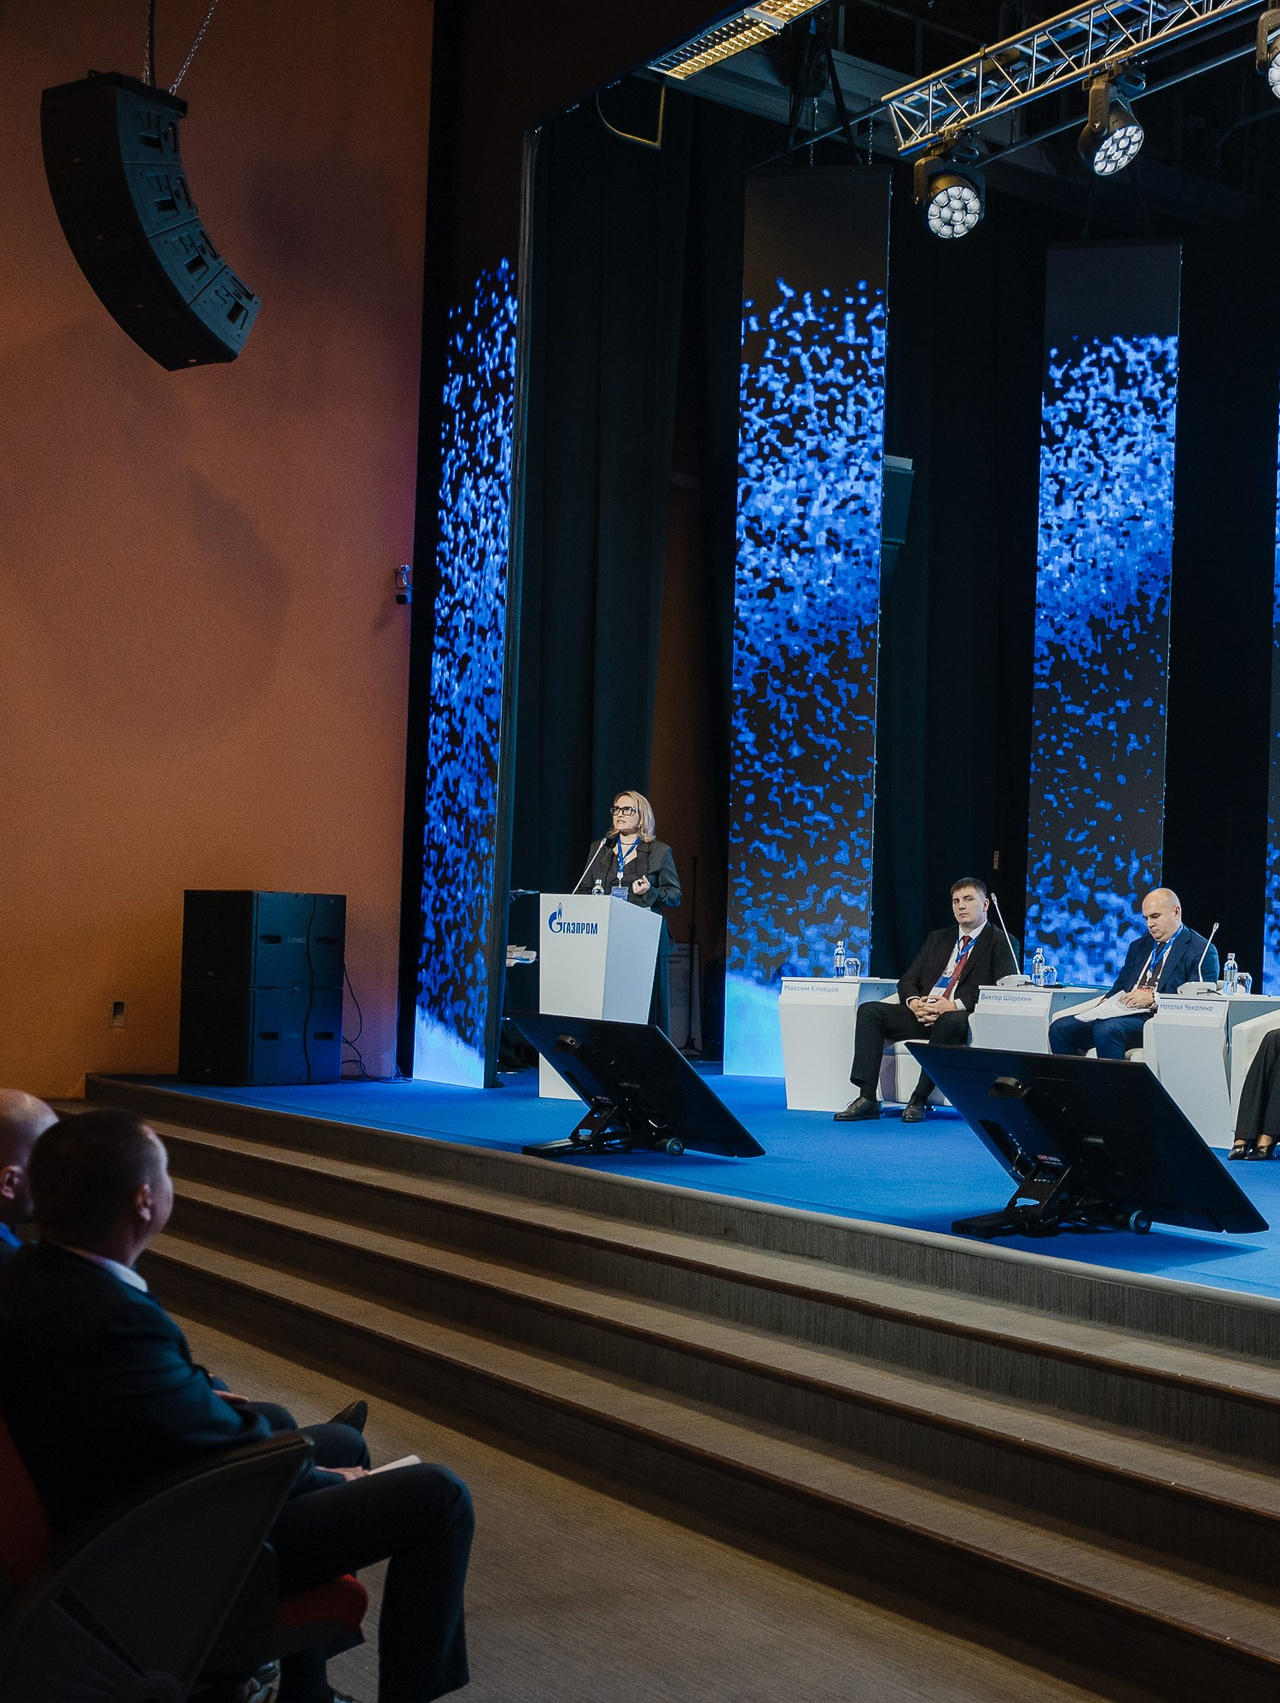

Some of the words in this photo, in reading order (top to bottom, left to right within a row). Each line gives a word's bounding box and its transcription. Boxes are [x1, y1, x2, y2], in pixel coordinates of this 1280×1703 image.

[562, 921, 598, 935] ГАЗПРОМ
[784, 984, 810, 992] Максим
[980, 993, 1003, 1002] Виктор
[1160, 1002, 1184, 1010] Наталья
